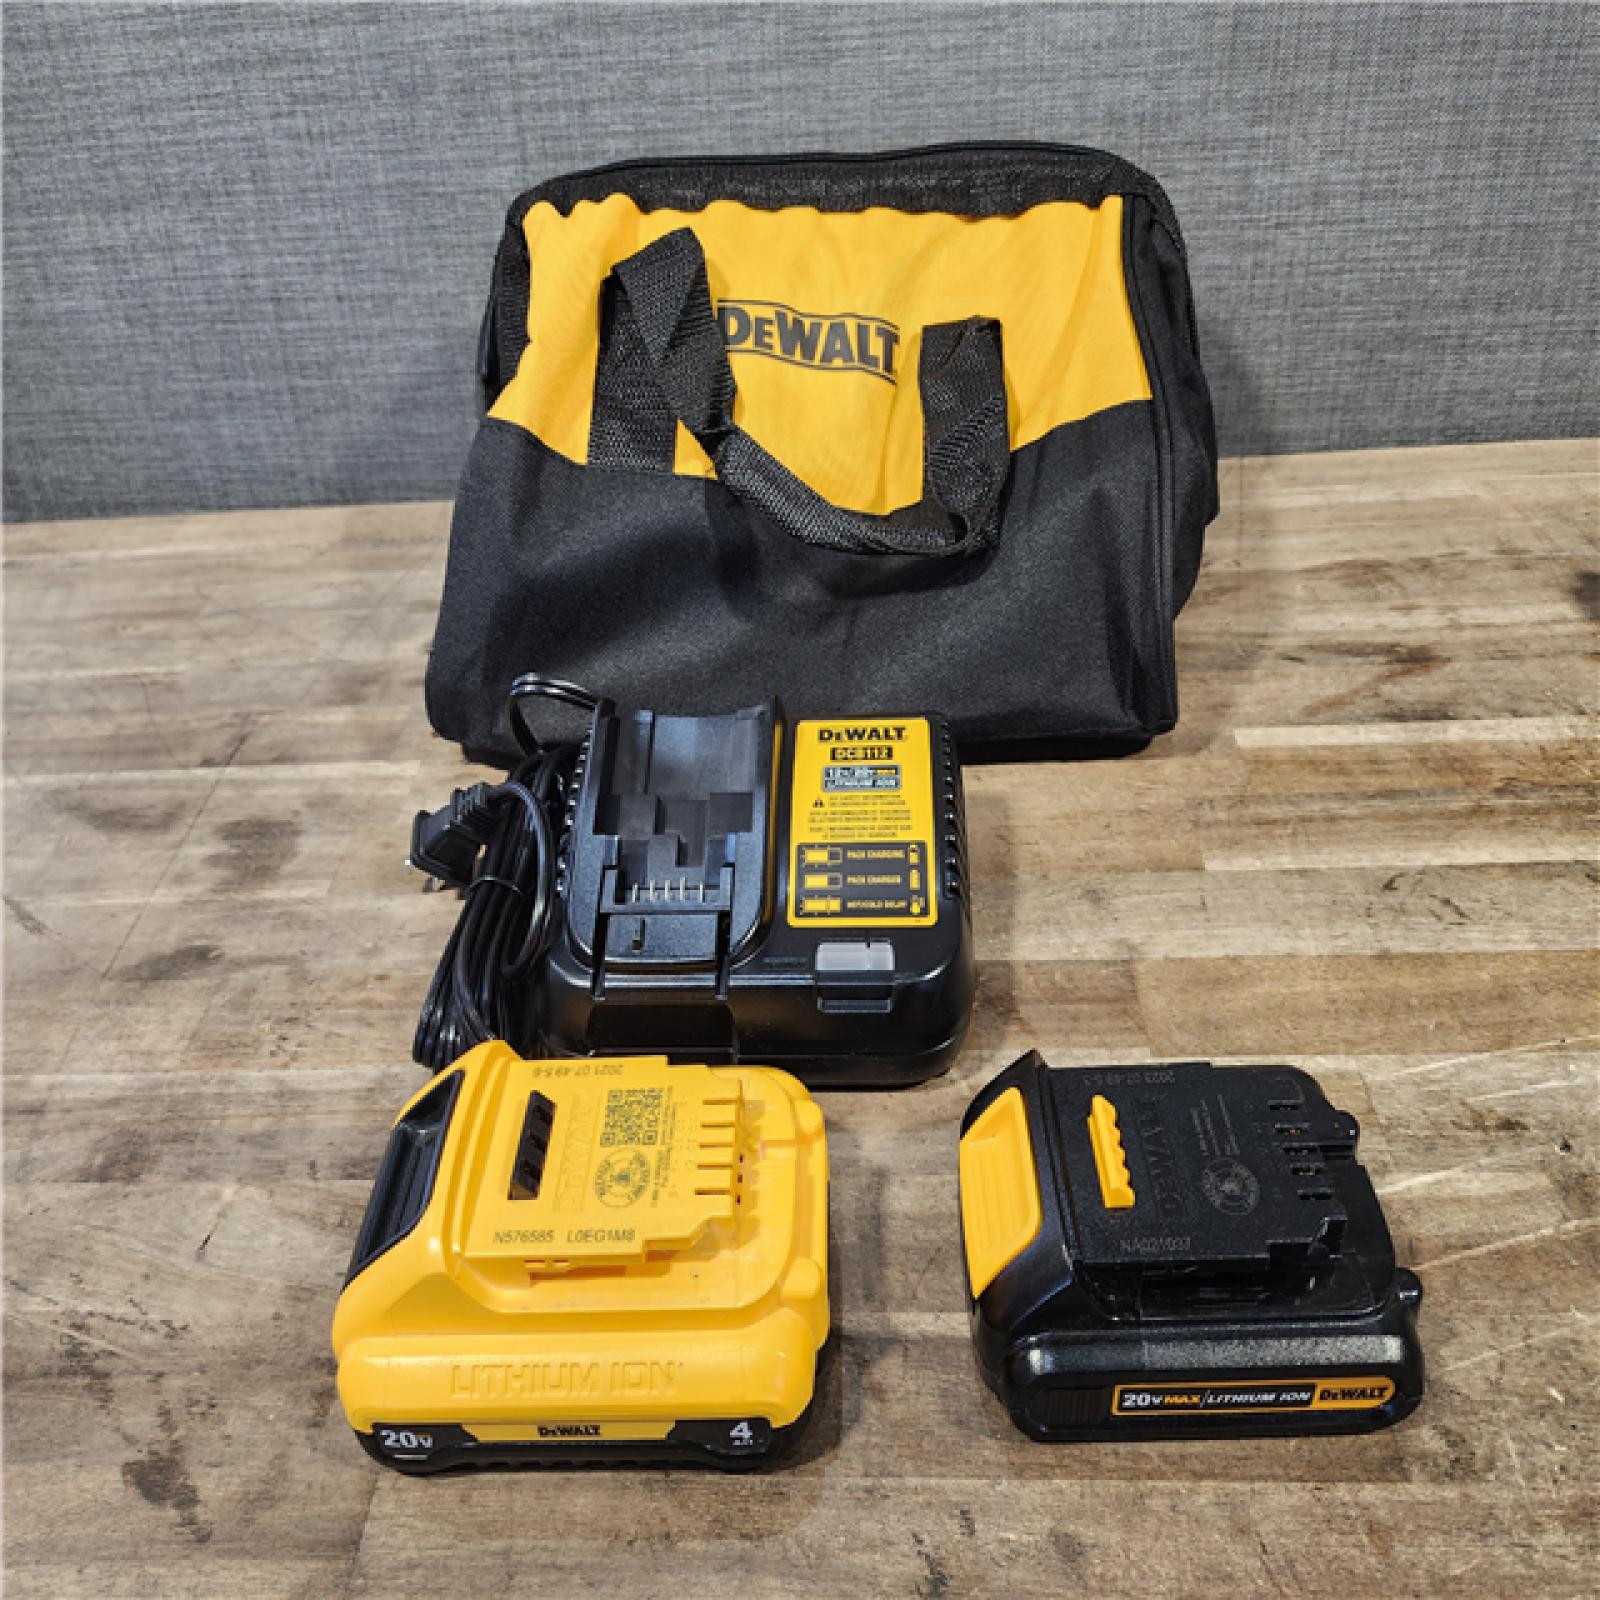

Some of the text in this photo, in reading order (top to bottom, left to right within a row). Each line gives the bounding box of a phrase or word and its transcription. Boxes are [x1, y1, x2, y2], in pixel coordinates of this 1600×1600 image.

[450, 1360, 676, 1400] LITHIUM ION
[1279, 1390, 1312, 1402] ION
[729, 1421, 753, 1439] 4
